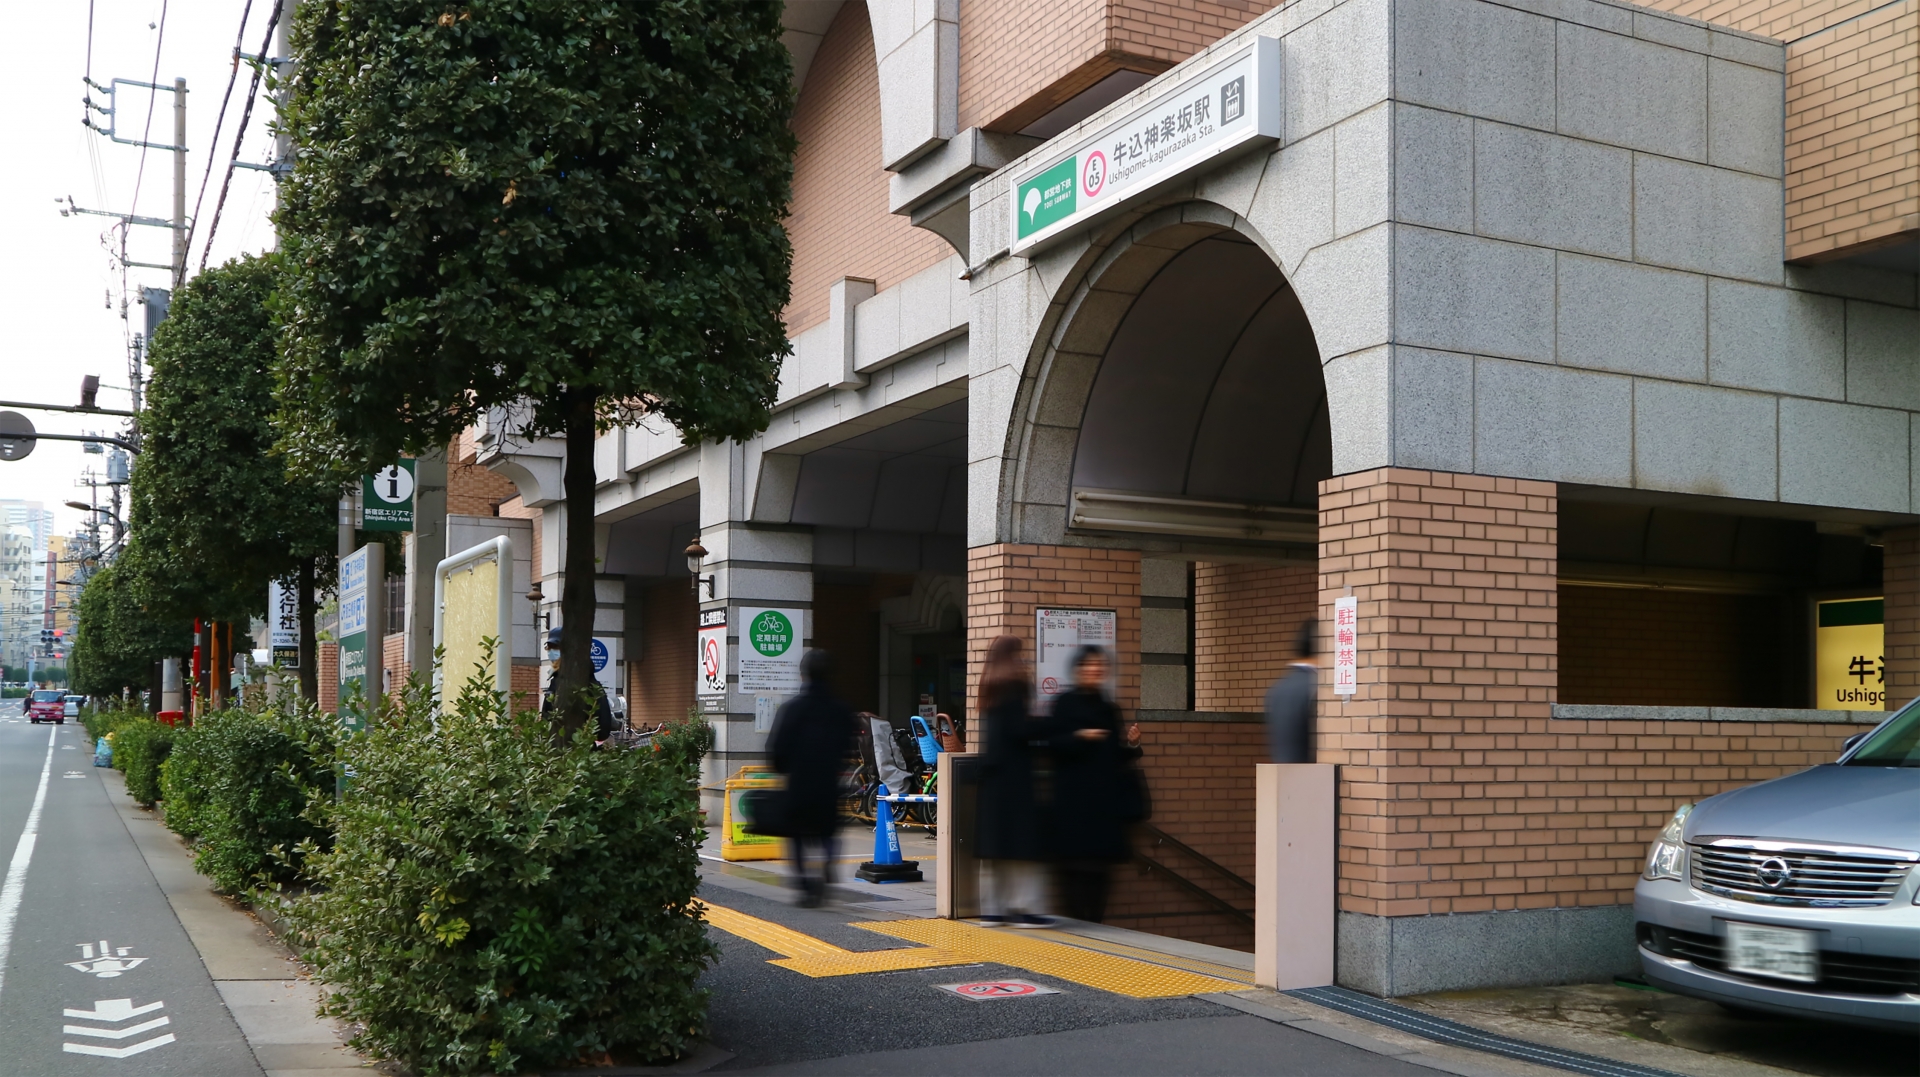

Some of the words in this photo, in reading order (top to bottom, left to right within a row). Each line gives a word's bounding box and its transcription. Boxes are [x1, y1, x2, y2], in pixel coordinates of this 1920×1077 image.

[1113, 94, 1210, 167] 牛込神楽坂駅
[1108, 132, 1197, 185] Ushigome-kagurazaka
[1199, 123, 1216, 139] Sta.
[1092, 159, 1097, 171] E
[1088, 172, 1100, 188] 05
[756, 633, 787, 643] 定期利用
[1338, 607, 1354, 685] 駐輪禁止
[760, 643, 783, 652] 駐輪場
